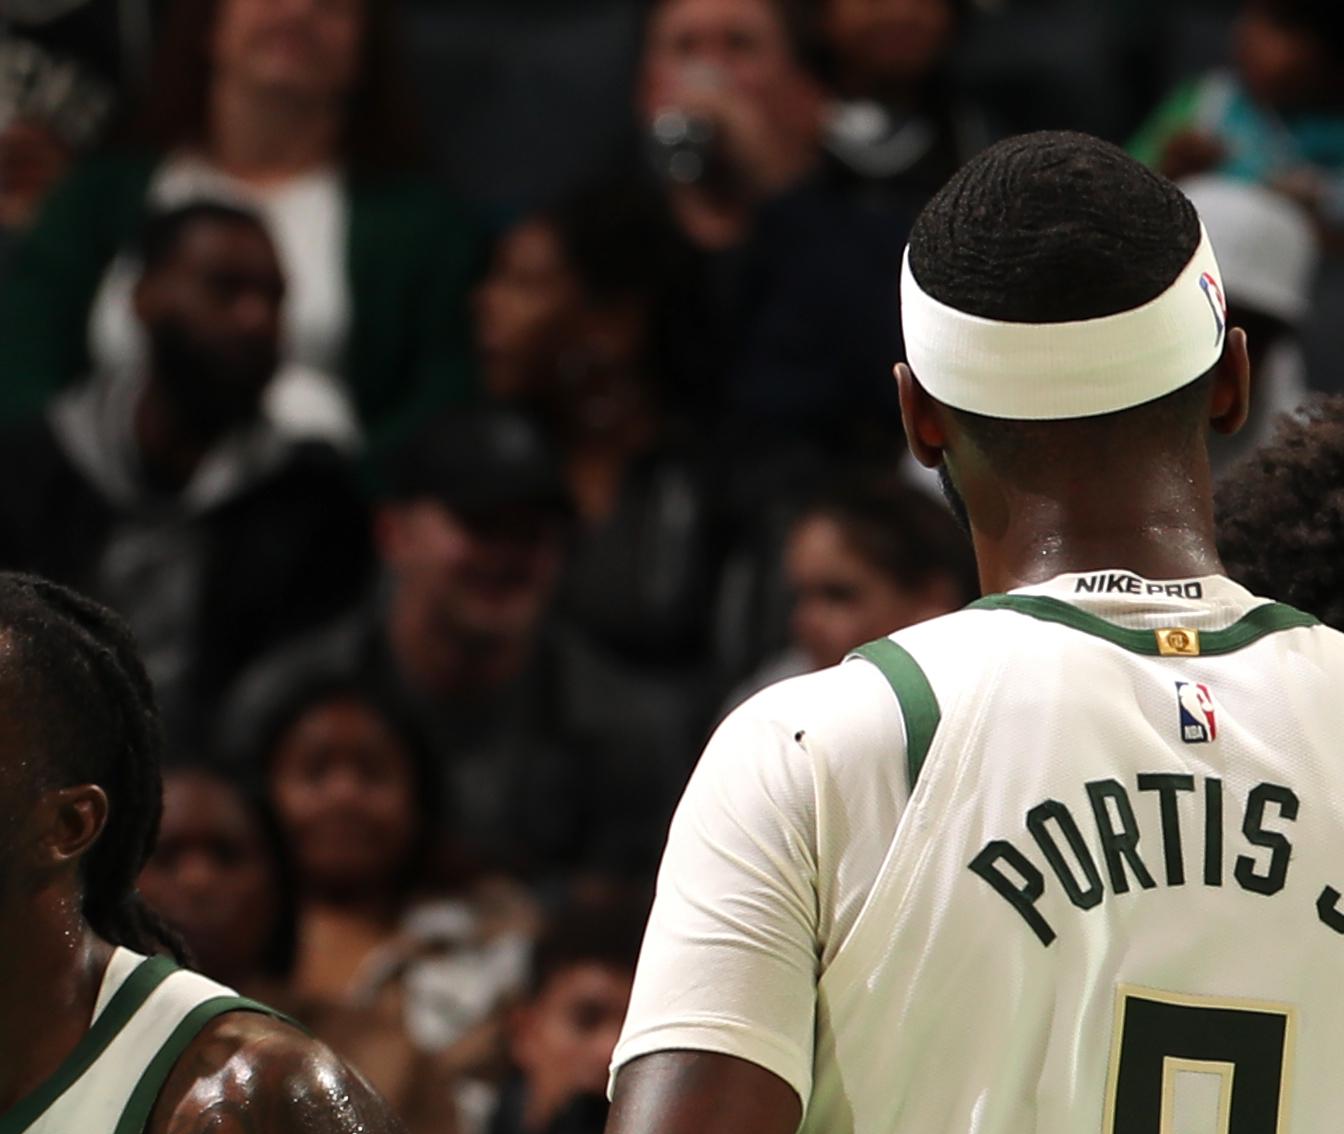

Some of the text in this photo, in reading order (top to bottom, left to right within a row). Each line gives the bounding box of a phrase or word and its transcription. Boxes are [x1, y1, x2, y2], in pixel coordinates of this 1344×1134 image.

[1074, 574, 1203, 600] NIKE PRO
[967, 772, 1301, 948] PORTIS
